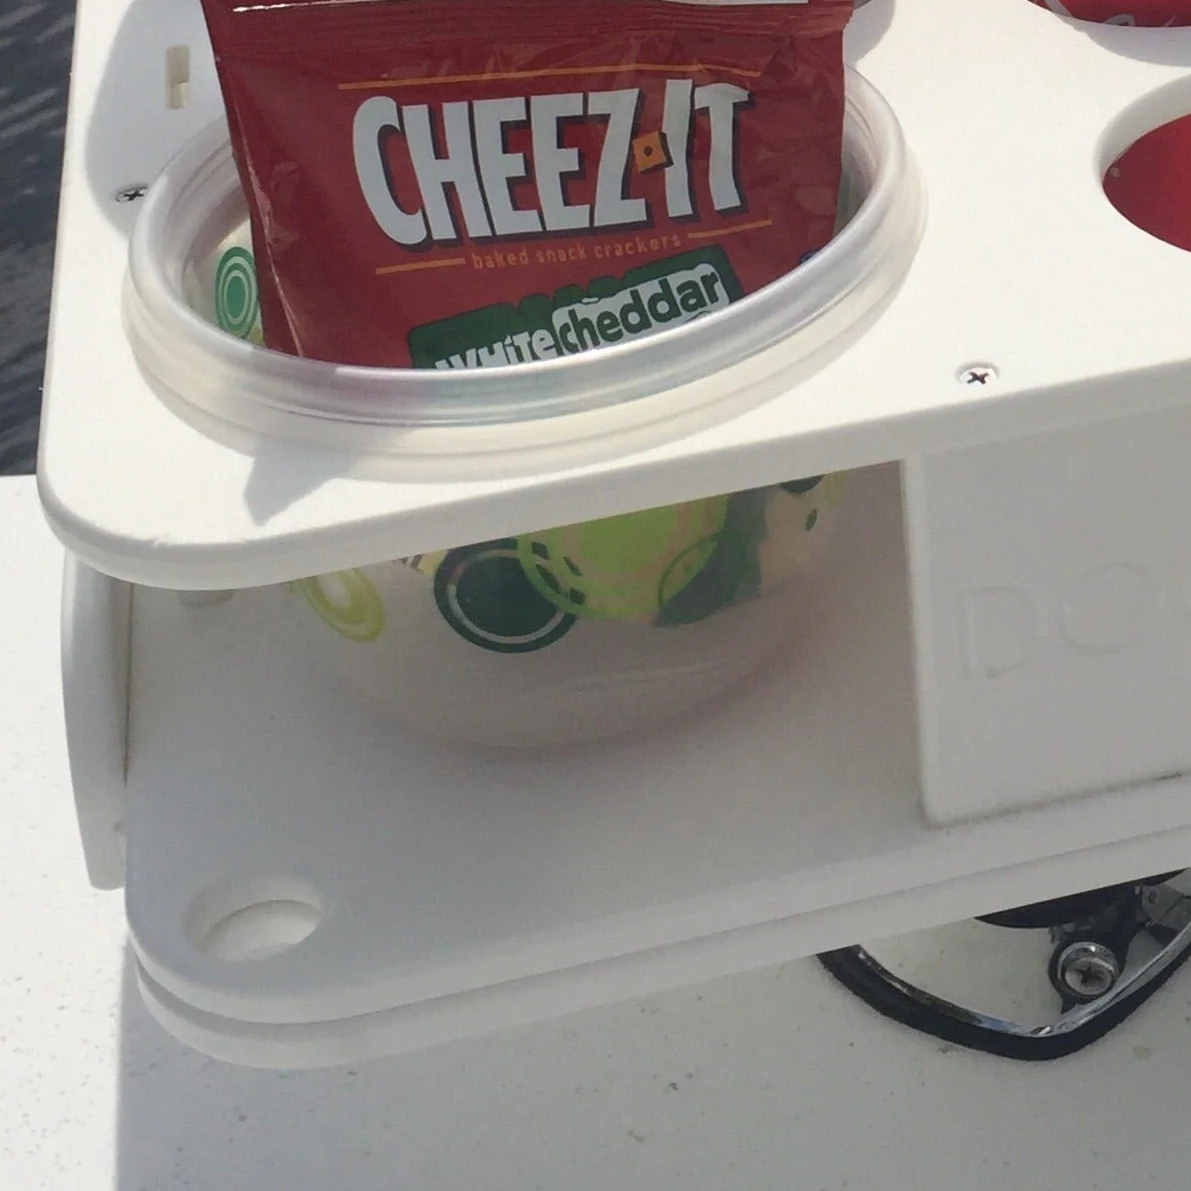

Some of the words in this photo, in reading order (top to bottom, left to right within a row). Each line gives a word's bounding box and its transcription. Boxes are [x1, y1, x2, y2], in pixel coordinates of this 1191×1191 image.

[473, 245, 529, 270] baked
[536, 241, 588, 264] snack
[594, 232, 683, 259] crackers
[556, 268, 721, 357] cheddar
